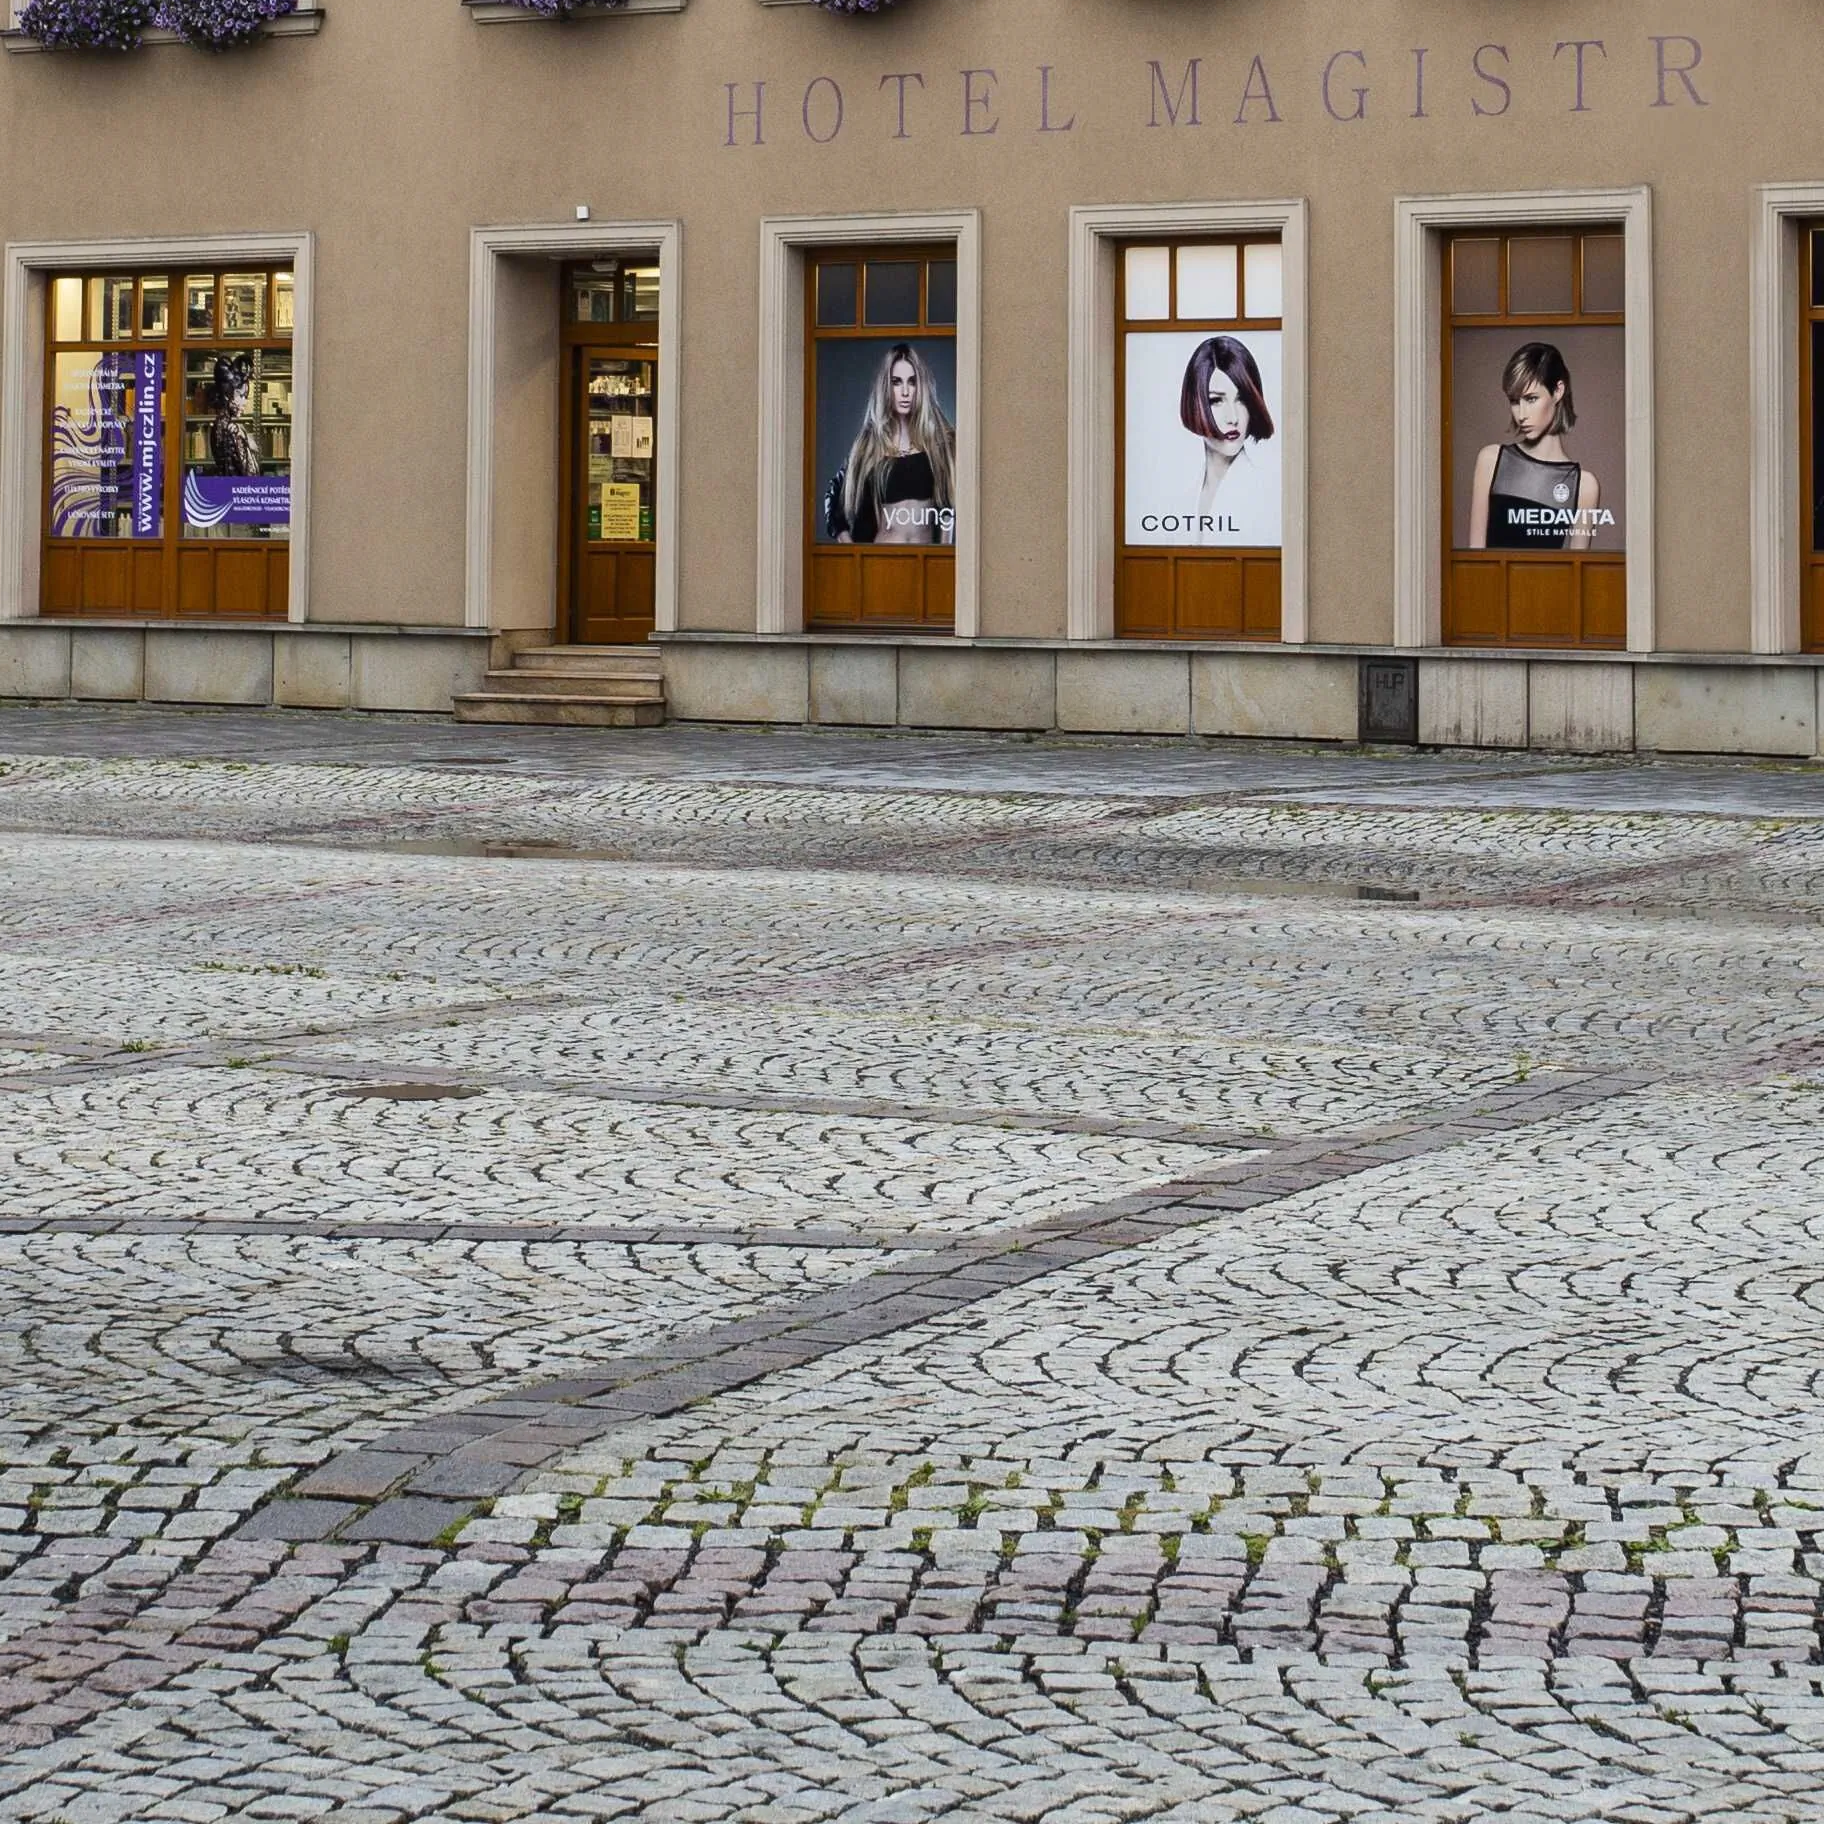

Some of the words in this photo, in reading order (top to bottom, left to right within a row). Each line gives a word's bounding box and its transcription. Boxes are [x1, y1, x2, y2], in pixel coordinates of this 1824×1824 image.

[722, 64, 1077, 148] HOTEL
[1146, 34, 1710, 128] MAGISTR
[138, 352, 158, 533] www.mjczlin.cz
[882, 507, 955, 536] young
[1141, 515, 1240, 532] COTRIL
[1507, 508, 1616, 525] MEDAVITA
[1526, 528, 1550, 536] STILE
[1553, 528, 1597, 537] NATURALE
